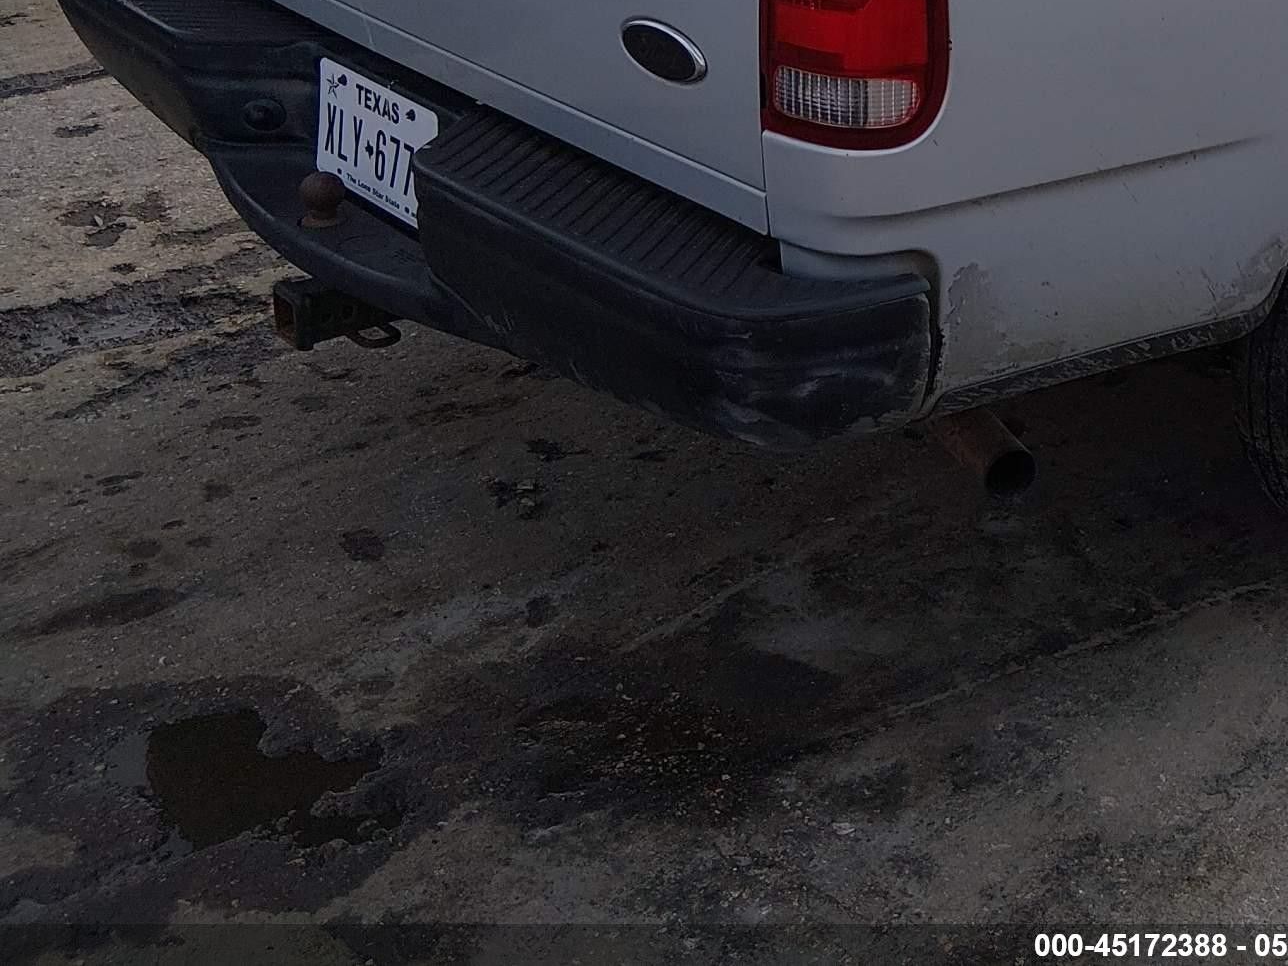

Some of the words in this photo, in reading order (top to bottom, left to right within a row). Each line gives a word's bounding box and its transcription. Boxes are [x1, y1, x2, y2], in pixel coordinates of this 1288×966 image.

[355, 83, 400, 125] TEXAS
[324, 102, 363, 168] XLY
[346, 172, 357, 185] The
[357, 179, 371, 193] Lone
[372, 187, 385, 200] Star
